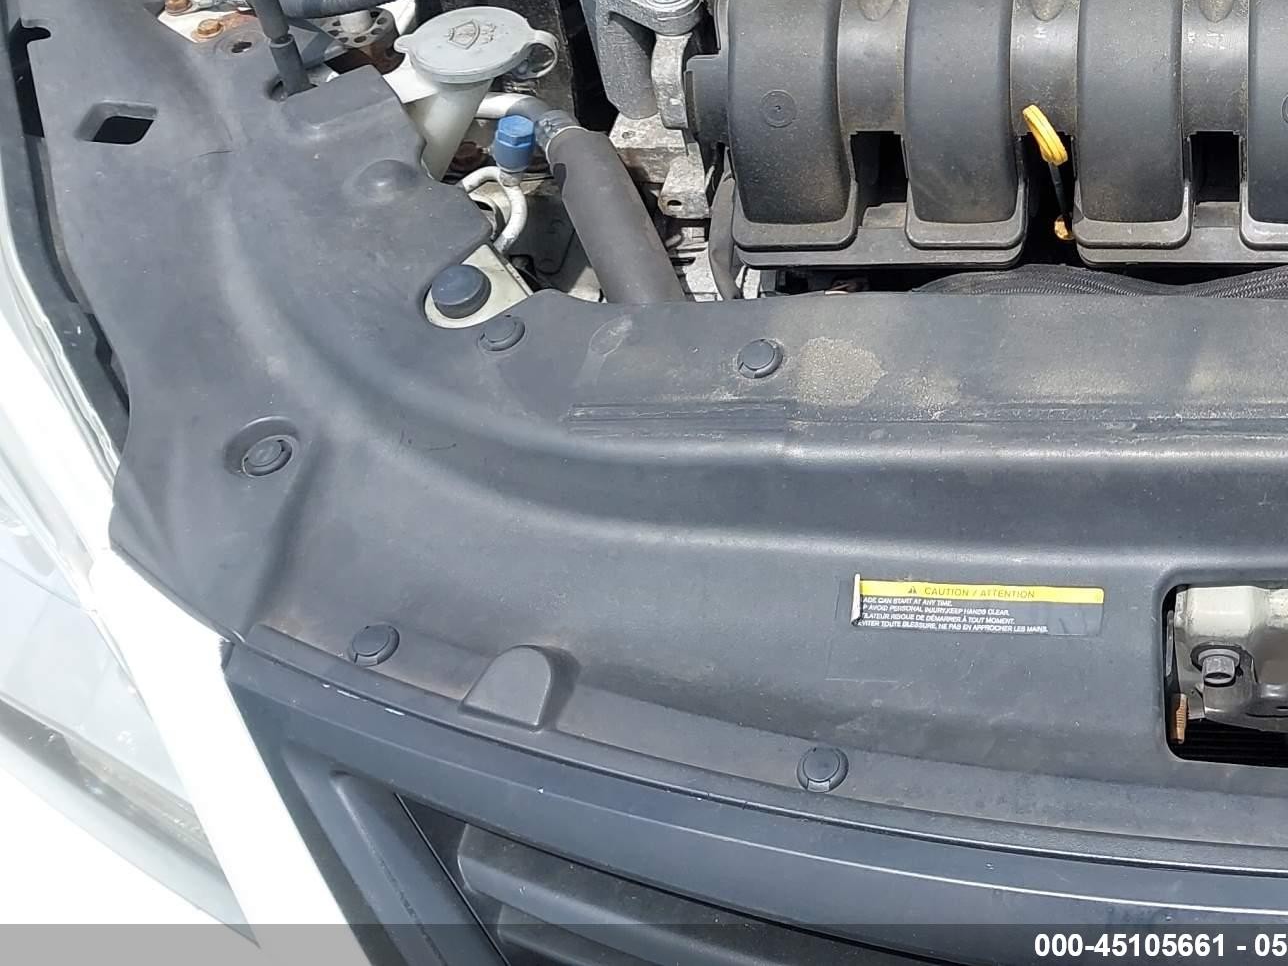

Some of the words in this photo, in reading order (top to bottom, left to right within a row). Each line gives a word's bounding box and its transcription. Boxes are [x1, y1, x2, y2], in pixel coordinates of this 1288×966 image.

[924, 586, 969, 597] CAUTION
[980, 588, 1035, 599] ATTENTION
[893, 597, 913, 605] START
[890, 605, 923, 613] PERSONAL
